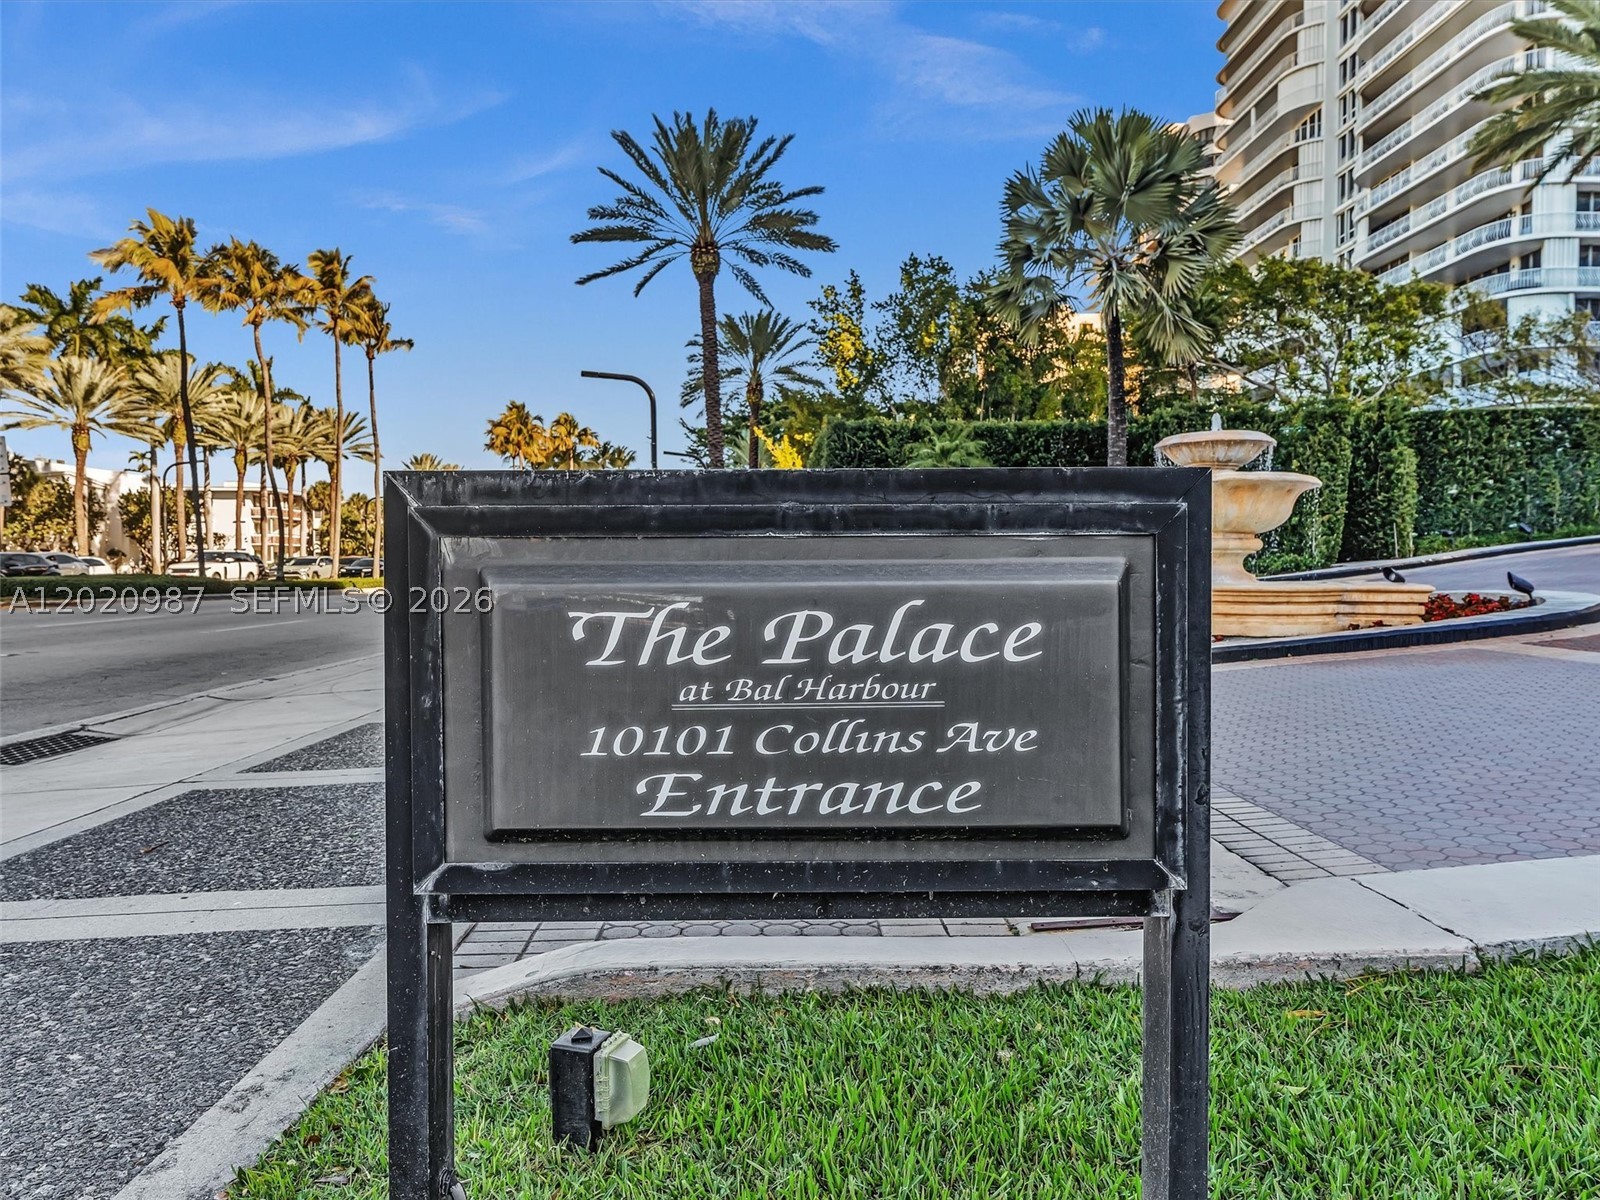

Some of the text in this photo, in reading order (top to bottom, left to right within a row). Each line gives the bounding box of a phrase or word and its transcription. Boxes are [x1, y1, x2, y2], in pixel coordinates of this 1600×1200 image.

[567, 599, 1043, 667] The Palace
[679, 673, 937, 702] at Bal Harbour
[580, 718, 1038, 757] 10101 Collins Ave
[635, 772, 982, 817] Entrance
